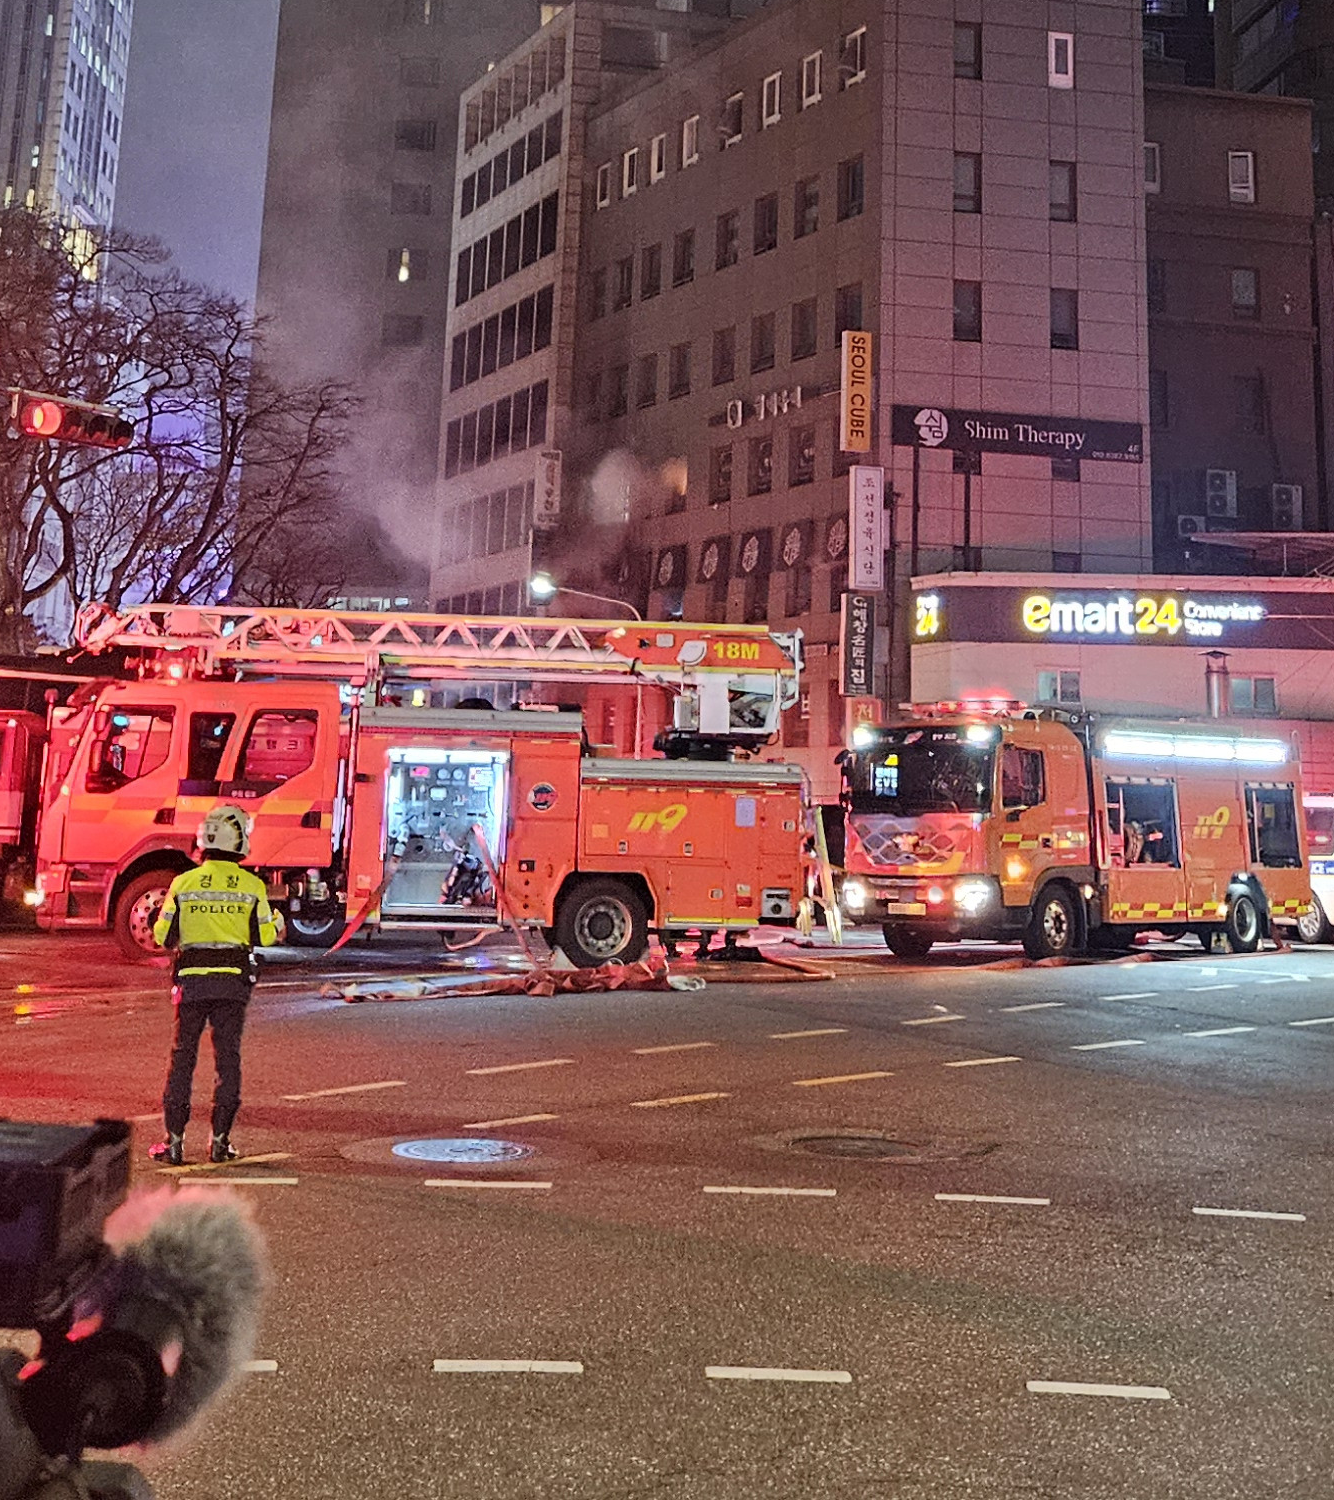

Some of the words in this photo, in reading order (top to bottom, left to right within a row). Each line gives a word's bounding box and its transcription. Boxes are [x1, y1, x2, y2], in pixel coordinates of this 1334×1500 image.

[850, 335, 866, 388] SEOUL
[850, 393, 866, 439] CUBE
[963, 420, 1009, 441] Shim
[1014, 423, 1086, 449] Therapy
[1022, 595, 1181, 636] emart24
[712, 641, 760, 660] 18M
[626, 803, 688, 832] 119
[189, 904, 246, 914] POLICE
